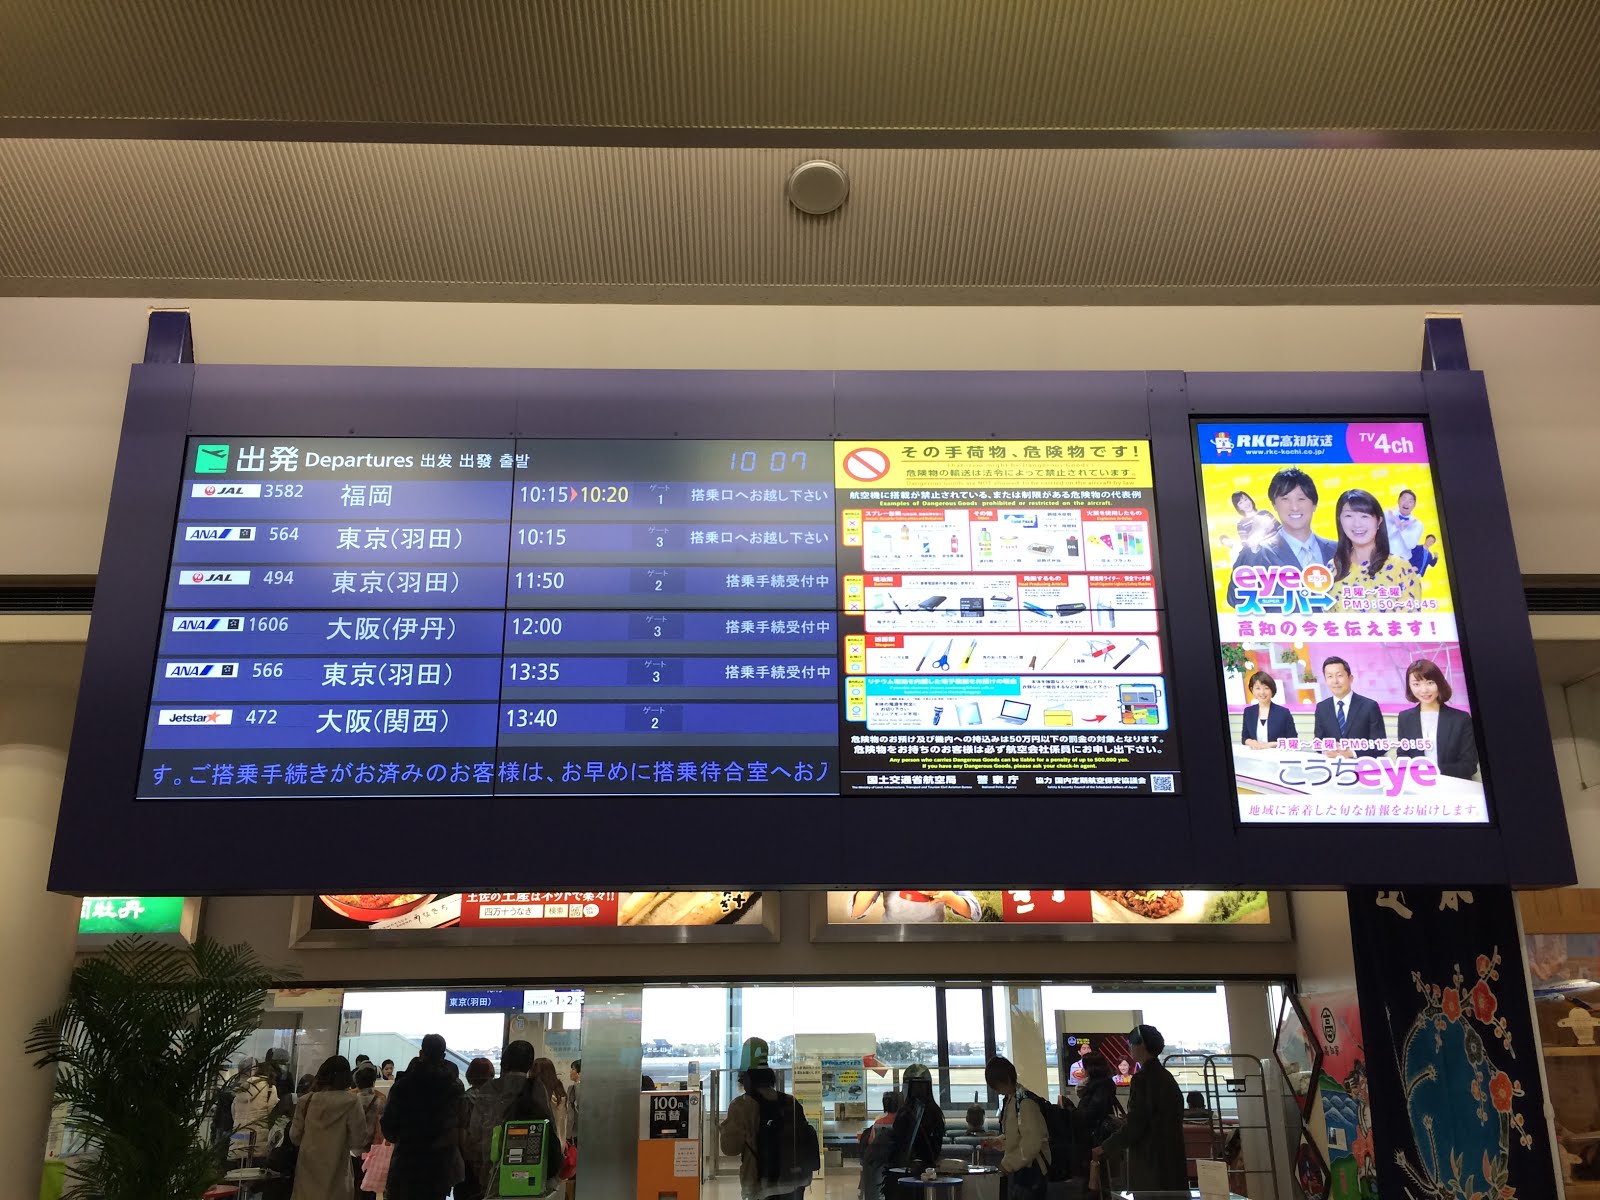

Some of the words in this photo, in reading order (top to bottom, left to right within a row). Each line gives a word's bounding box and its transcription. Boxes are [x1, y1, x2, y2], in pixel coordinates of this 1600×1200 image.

[1237, 435, 1333, 448] RKC高知放送
[1359, 432, 1376, 442] TV
[1374, 433, 1414, 454] 4ch
[236, 446, 299, 473] 出発
[305, 452, 413, 471] Departures
[420, 454, 452, 468] 出发
[459, 454, 492, 468] 出發
[499, 454, 530, 468] 출발
[730, 452, 756, 472] 10
[770, 452, 807, 472] 07
[217, 487, 243, 495] JAL
[264, 484, 303, 498] 3582
[341, 484, 392, 507] 福岡
[521, 486, 568, 503] 10:15
[581, 486, 629, 503] 10:20
[691, 488, 828, 503] 搭乗口へお越し下さい
[658, 495, 664, 505] 1
[190, 530, 217, 539] ANA
[269, 527, 299, 541] 564
[337, 528, 462, 550] 東京(羽田)
[518, 528, 567, 546] 10:15
[690, 530, 828, 545] 搭乗口へお越し下さい
[656, 537, 664, 548] 3
[205, 573, 233, 582] JAL
[263, 571, 294, 585] 494
[332, 571, 459, 594] 東京(羽田)
[515, 572, 564, 589] 11:50
[726, 573, 829, 588] 搭乗手続受付中
[1234, 566, 1301, 596] eye
[655, 580, 663, 591] 2
[177, 620, 206, 630] ANA
[249, 617, 289, 632] 1606
[326, 617, 456, 640] 大阪(伊丹)
[512, 617, 562, 635] 12:00
[653, 626, 662, 637] 3
[725, 619, 830, 634] 搭乗手続受付中
[171, 666, 199, 676] ANA
[252, 663, 283, 678] 566
[321, 662, 452, 687] 東京(羽田)
[509, 663, 560, 681] 13:35
[652, 671, 660, 683] 3
[725, 664, 831, 680] 搭乗手続受付中
[169, 713, 207, 723] Jetstar
[246, 710, 278, 725] 472
[316, 709, 449, 734] 大阪(関西)
[506, 709, 557, 727] 13:40
[651, 718, 659, 729] 2
[484, 907, 532, 916] 四万十うなぎ
[449, 998, 492, 1007] 東京(羽田)
[654, 1097, 683, 1110] 100円
[654, 1110, 680, 1121] 両替
